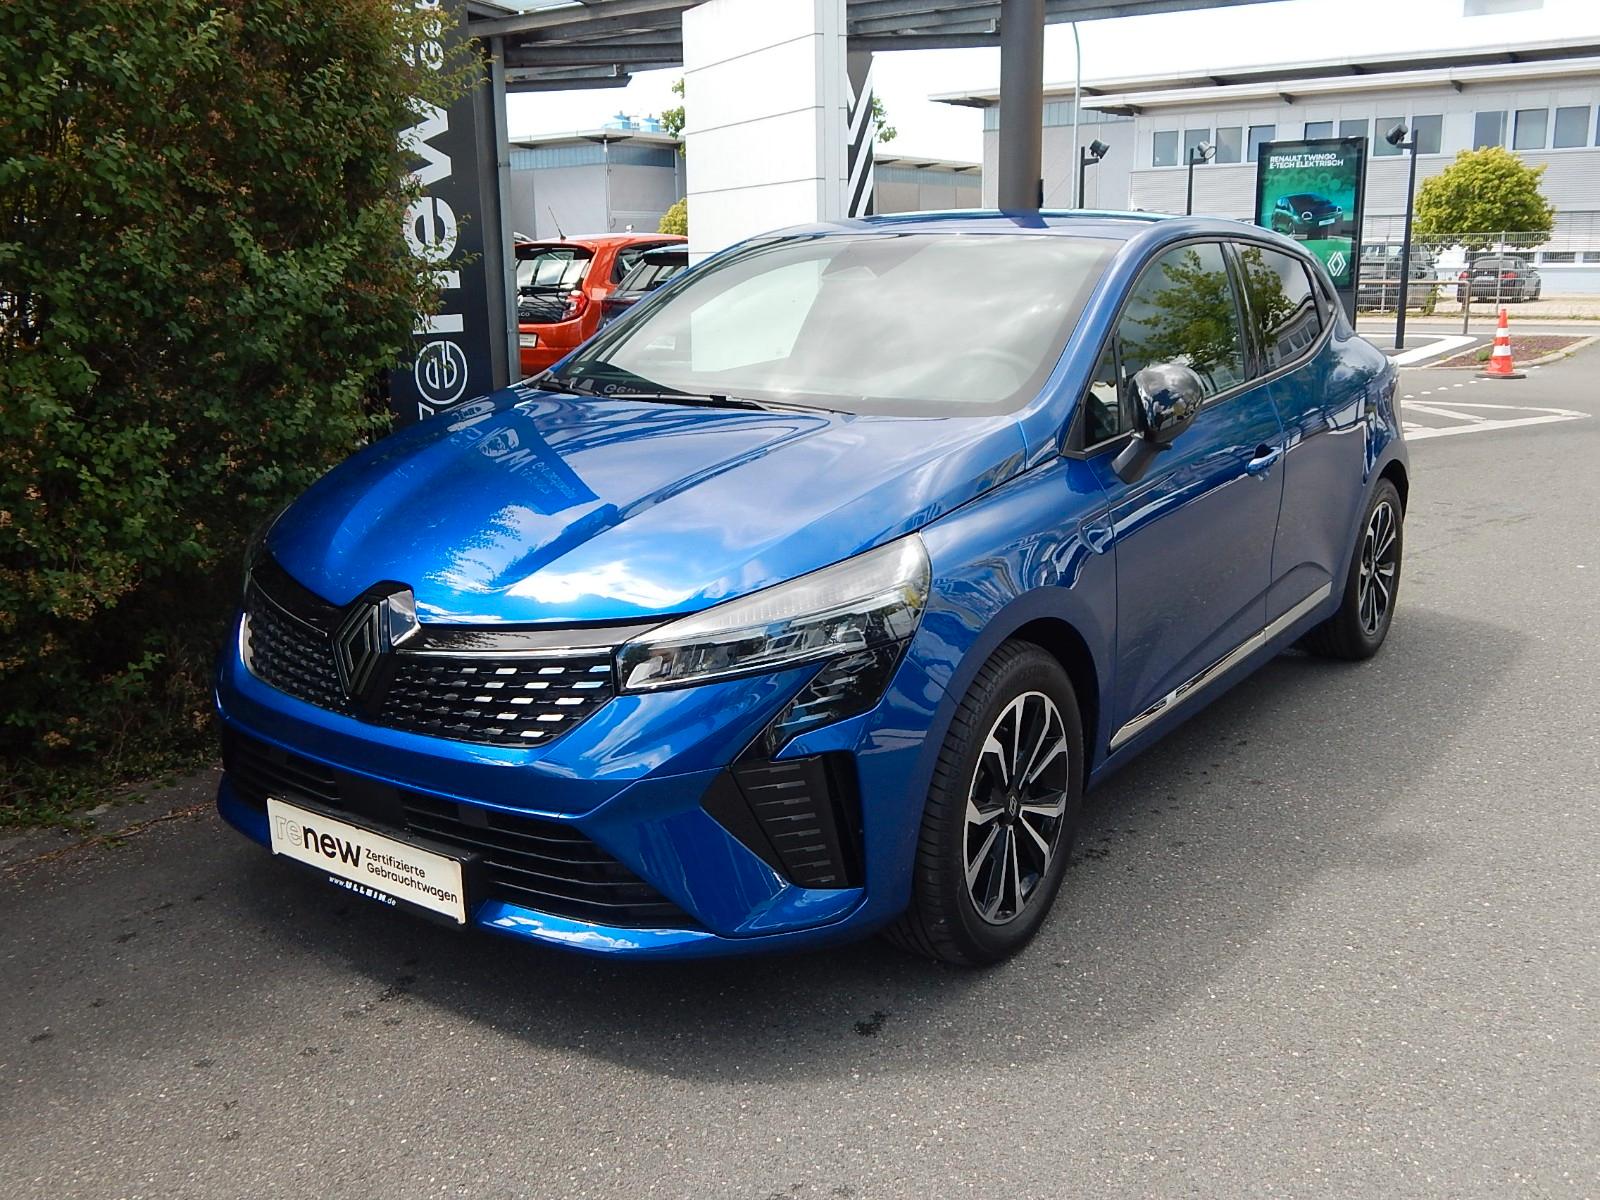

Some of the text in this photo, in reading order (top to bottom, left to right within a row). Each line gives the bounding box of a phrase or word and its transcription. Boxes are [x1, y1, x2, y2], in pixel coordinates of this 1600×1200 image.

[1269, 159, 1344, 169] E-TECH ELEKTRISCH
[1270, 153, 1336, 163] RENAULT TWINGO
[276, 816, 362, 868] renew
[365, 848, 426, 878] Zertifizierte
[366, 863, 458, 904] Gebrauchtwagen
